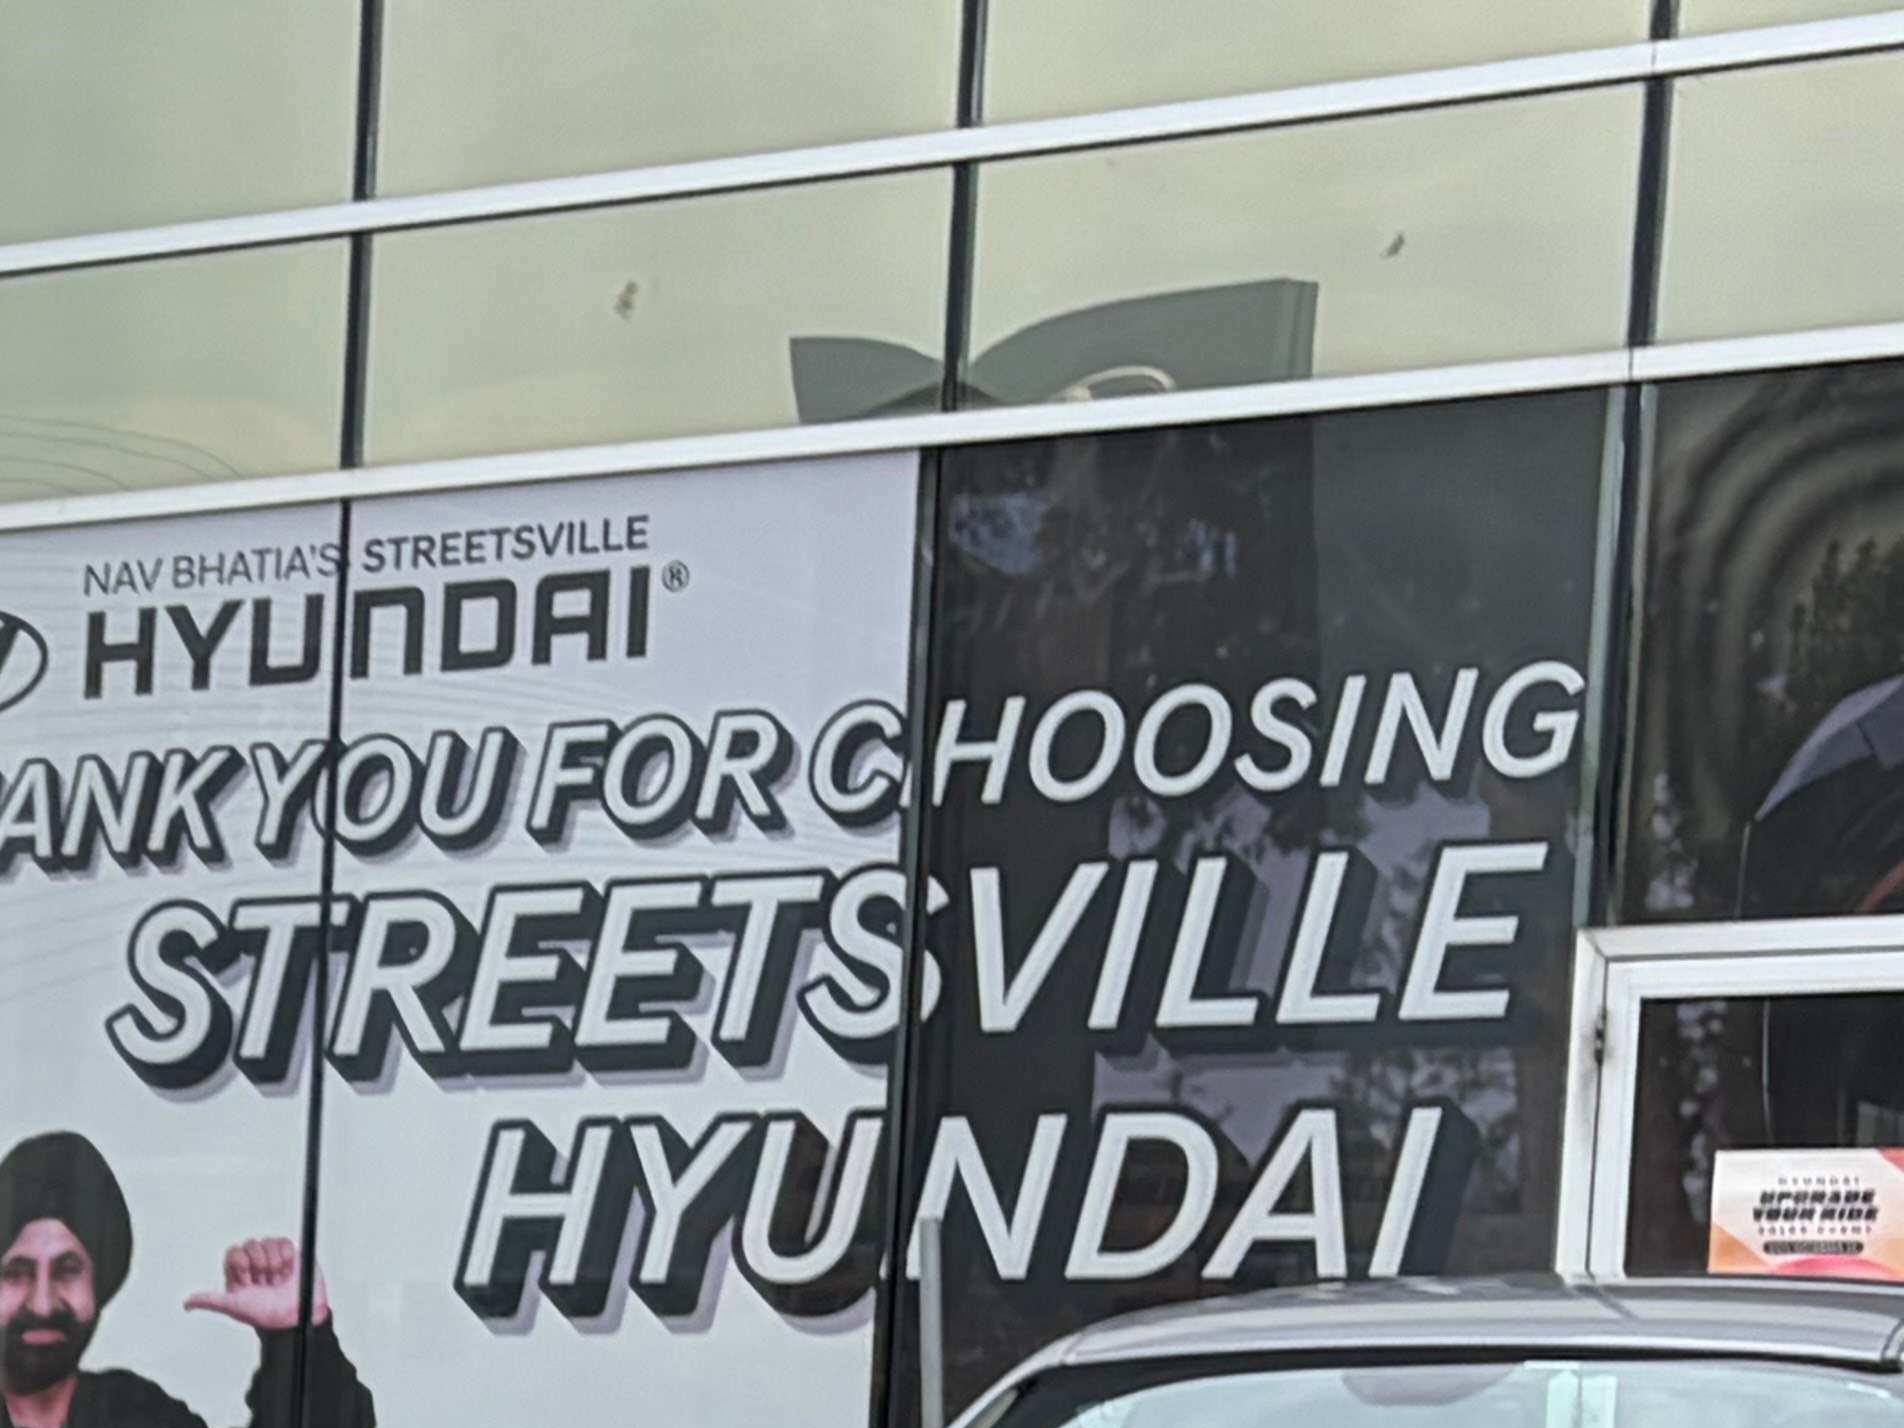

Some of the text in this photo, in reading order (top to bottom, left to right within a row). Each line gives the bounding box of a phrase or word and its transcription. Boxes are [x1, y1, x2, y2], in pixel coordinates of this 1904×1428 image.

[83, 515, 649, 597] NAV BHATIA'S STREETSVILLE
[249, 728, 520, 859] YOU
[526, 710, 790, 848] FOR
[810, 660, 1586, 825] CHOOSING
[106, 844, 1550, 1087] STREETSVILLE
[454, 1104, 1472, 1318] HYUNDAI
[1753, 1207, 1815, 1221] YOUR
[1760, 1188, 1875, 1204] UPGRADE
